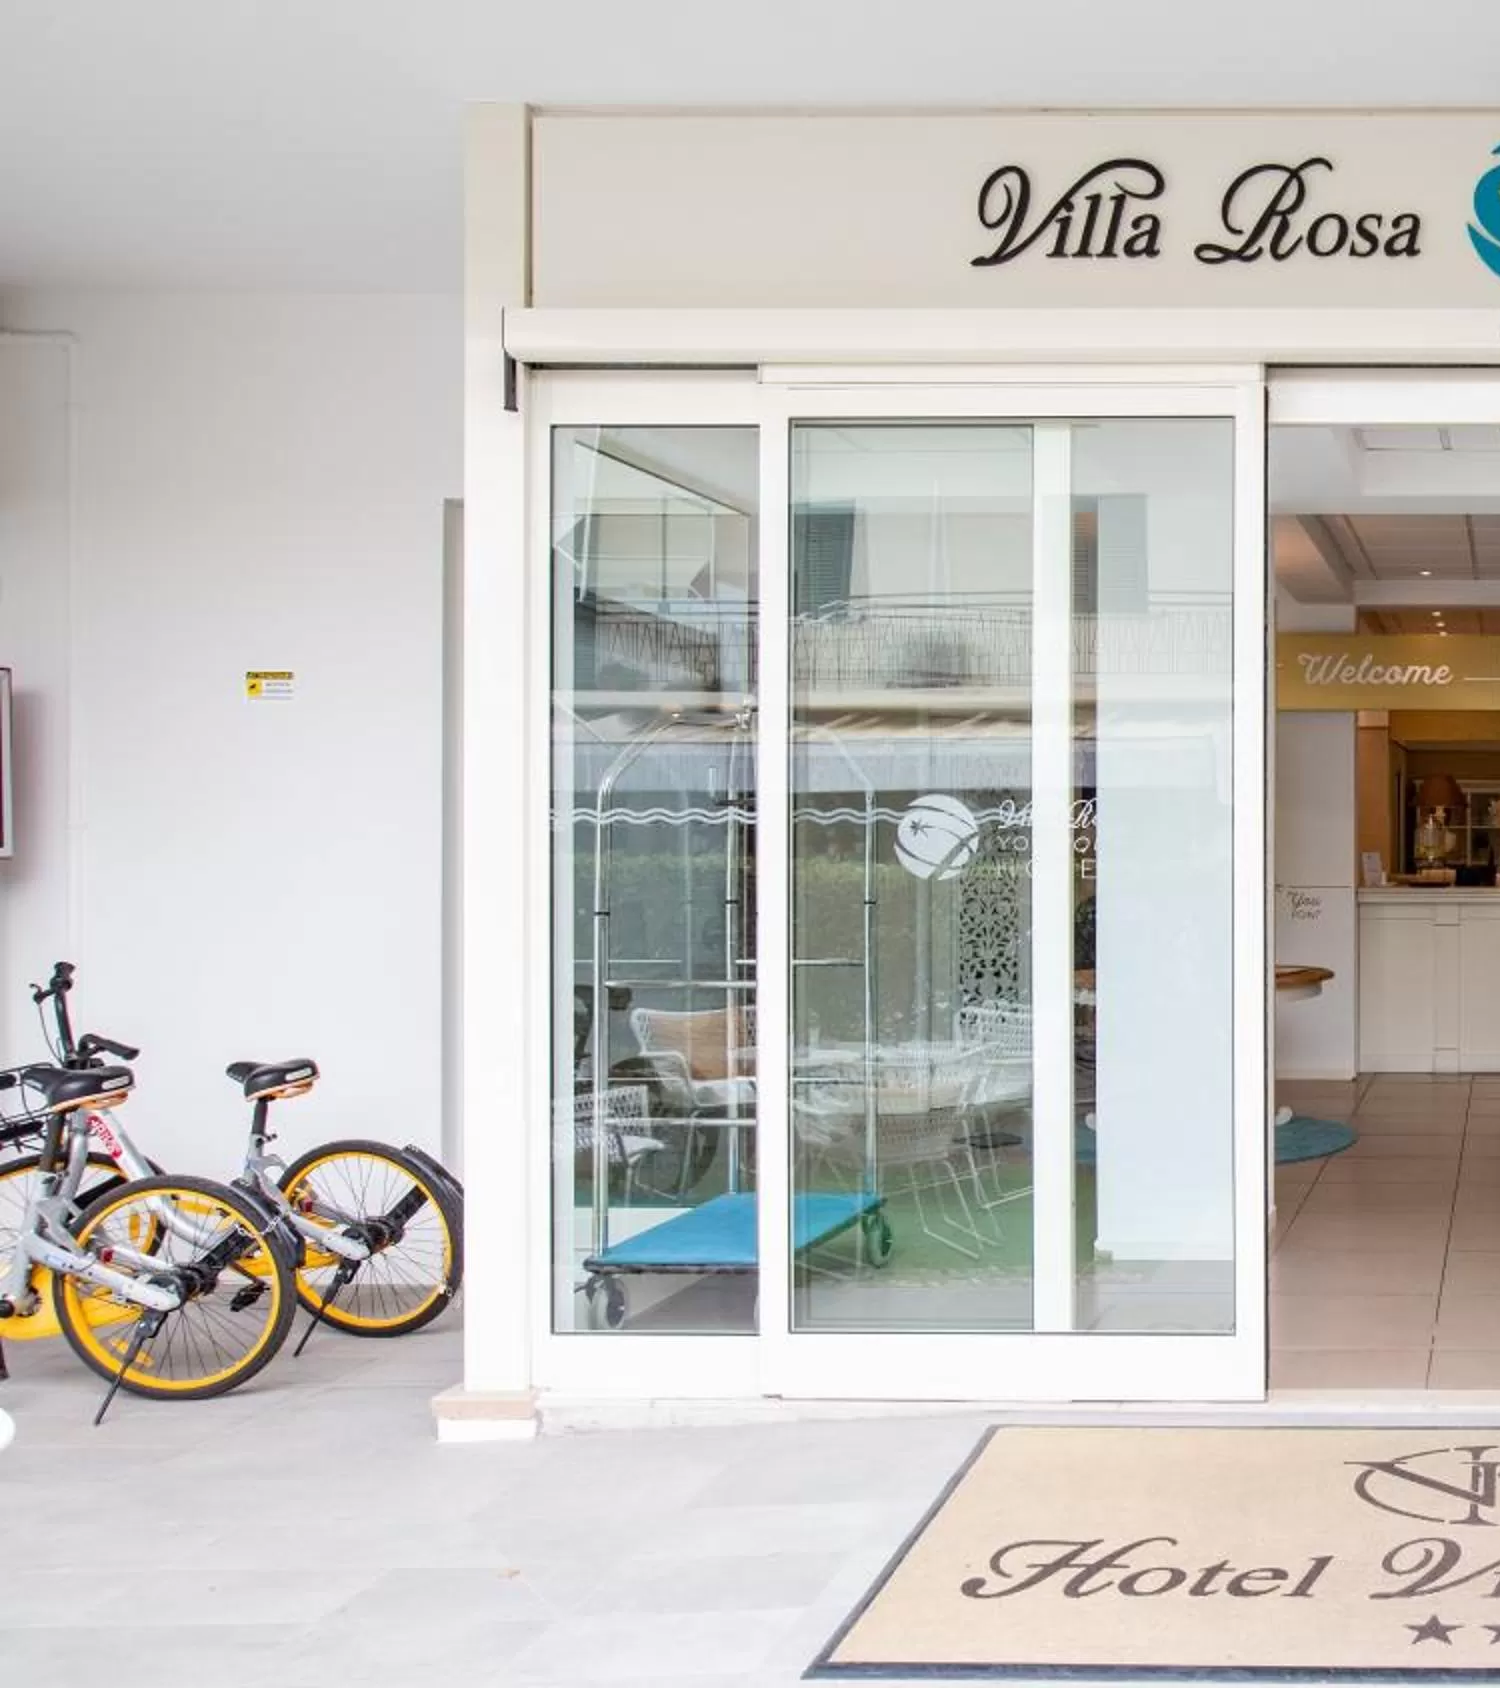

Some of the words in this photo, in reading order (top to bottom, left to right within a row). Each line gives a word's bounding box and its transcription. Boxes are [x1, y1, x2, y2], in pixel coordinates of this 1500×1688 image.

[970, 158, 1165, 266] Villa
[1194, 157, 1421, 264] Rosa
[1298, 653, 1453, 685] Welcome
[961, 1537, 1334, 1599] Hotel
